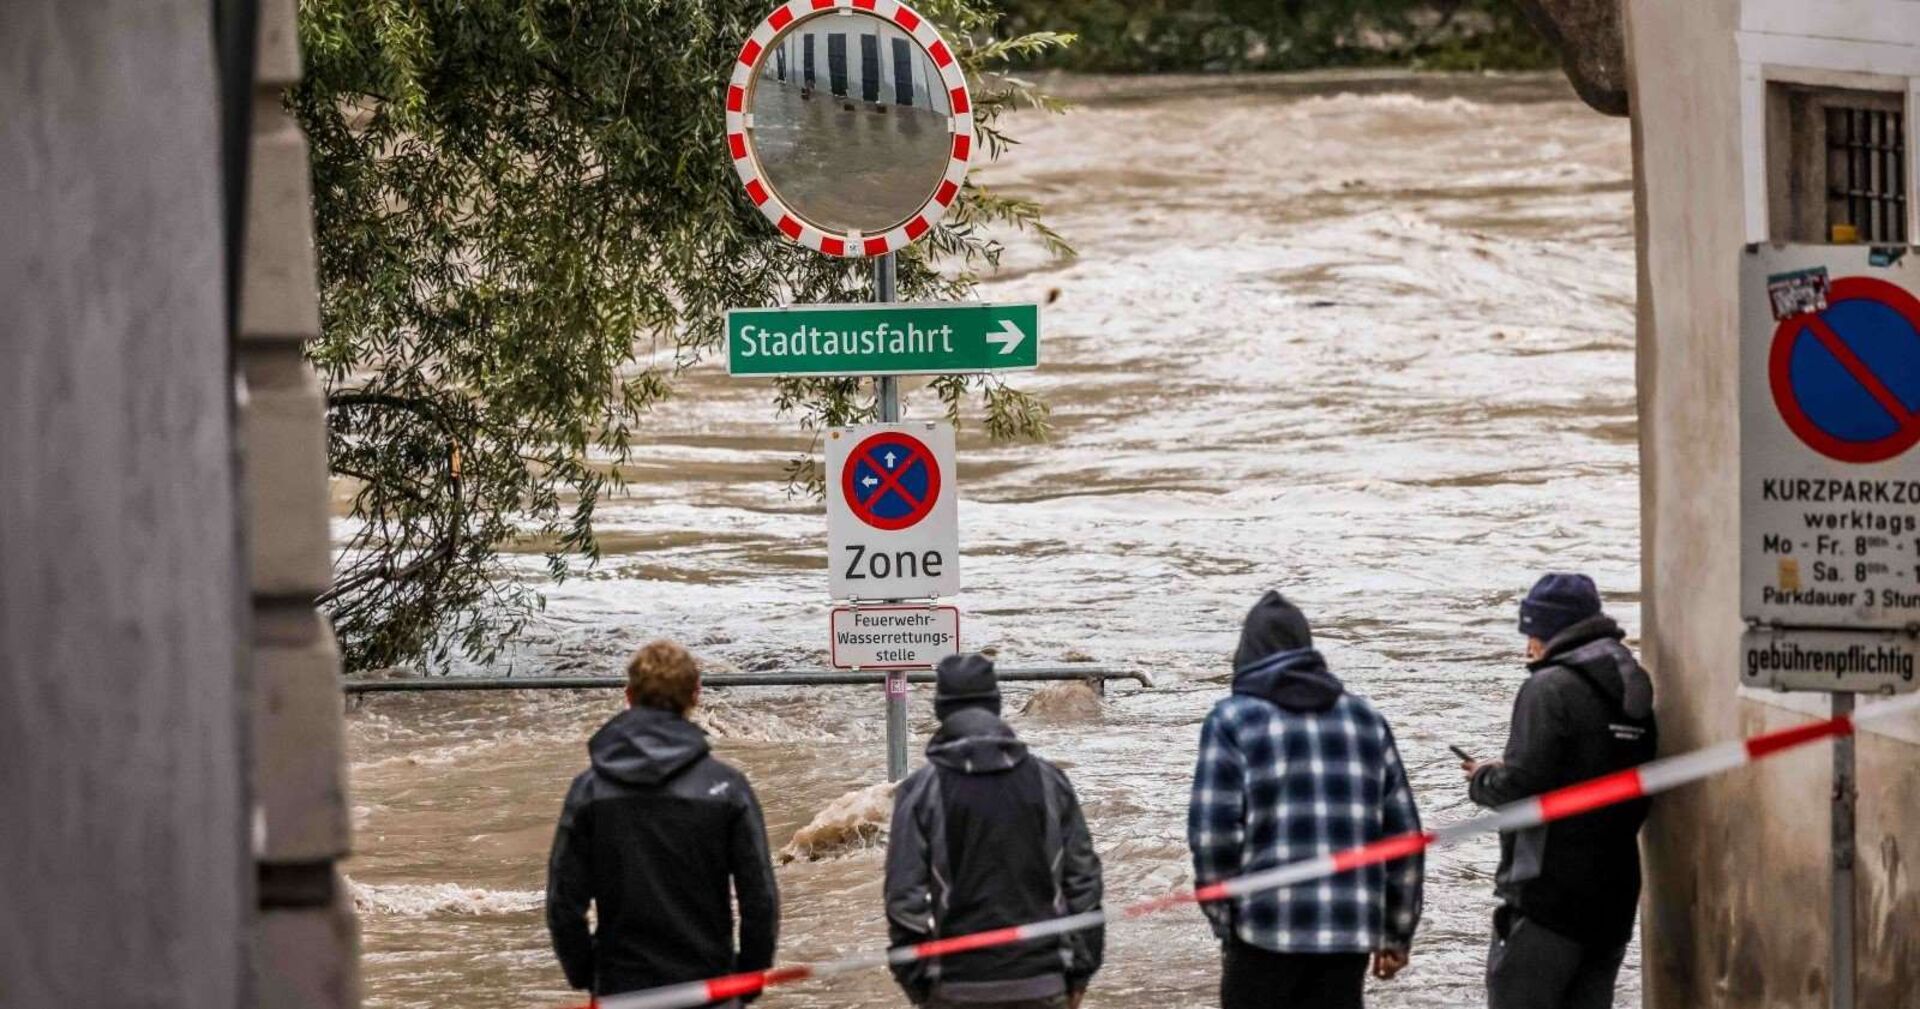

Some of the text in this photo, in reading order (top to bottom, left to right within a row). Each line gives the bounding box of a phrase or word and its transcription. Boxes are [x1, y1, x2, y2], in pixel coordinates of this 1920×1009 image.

[740, 322, 954, 357] Stadtausfahrt
[1762, 478, 1920, 505] KURZPARKZO
[1803, 511, 1916, 536] werktags
[1763, 533, 1793, 554] Mo
[1816, 534, 1845, 556] Fr.
[845, 544, 943, 580] Zone
[1812, 560, 1845, 582] Sa.
[1762, 586, 1857, 607] Parkdauer
[1864, 588, 1876, 608] 3
[854, 613, 936, 627] Feuerwehr-
[837, 631, 954, 648] Wasserrettungs-
[876, 648, 916, 662] stelle
[1747, 642, 1914, 680] gebührenpflichtig
